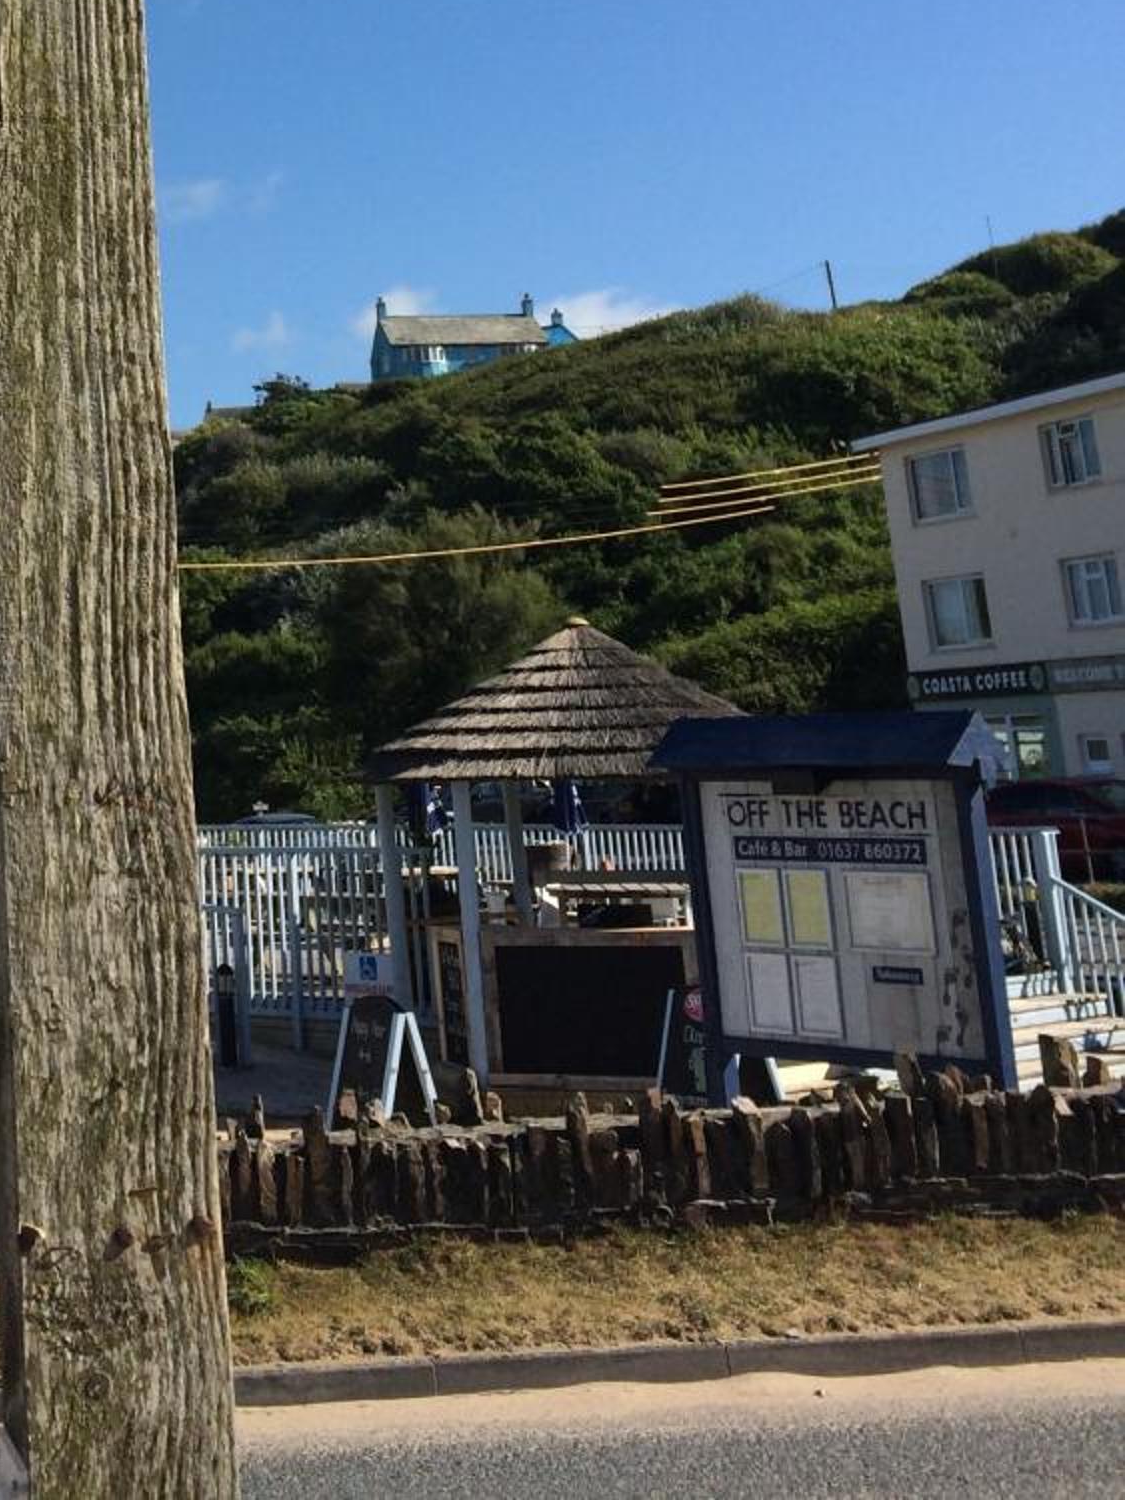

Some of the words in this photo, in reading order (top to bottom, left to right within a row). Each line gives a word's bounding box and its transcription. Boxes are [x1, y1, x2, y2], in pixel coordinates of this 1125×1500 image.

[975, 670, 1028, 690] COFFEE
[727, 800, 769, 827] OFF
[781, 800, 827, 828] THE
[839, 800, 927, 829] BEACH
[738, 840, 767, 856] Café
[771, 842, 782, 857] &
[785, 841, 807, 857] Bar
[818, 842, 859, 859] 01637
[864, 843, 922, 861] 860372
